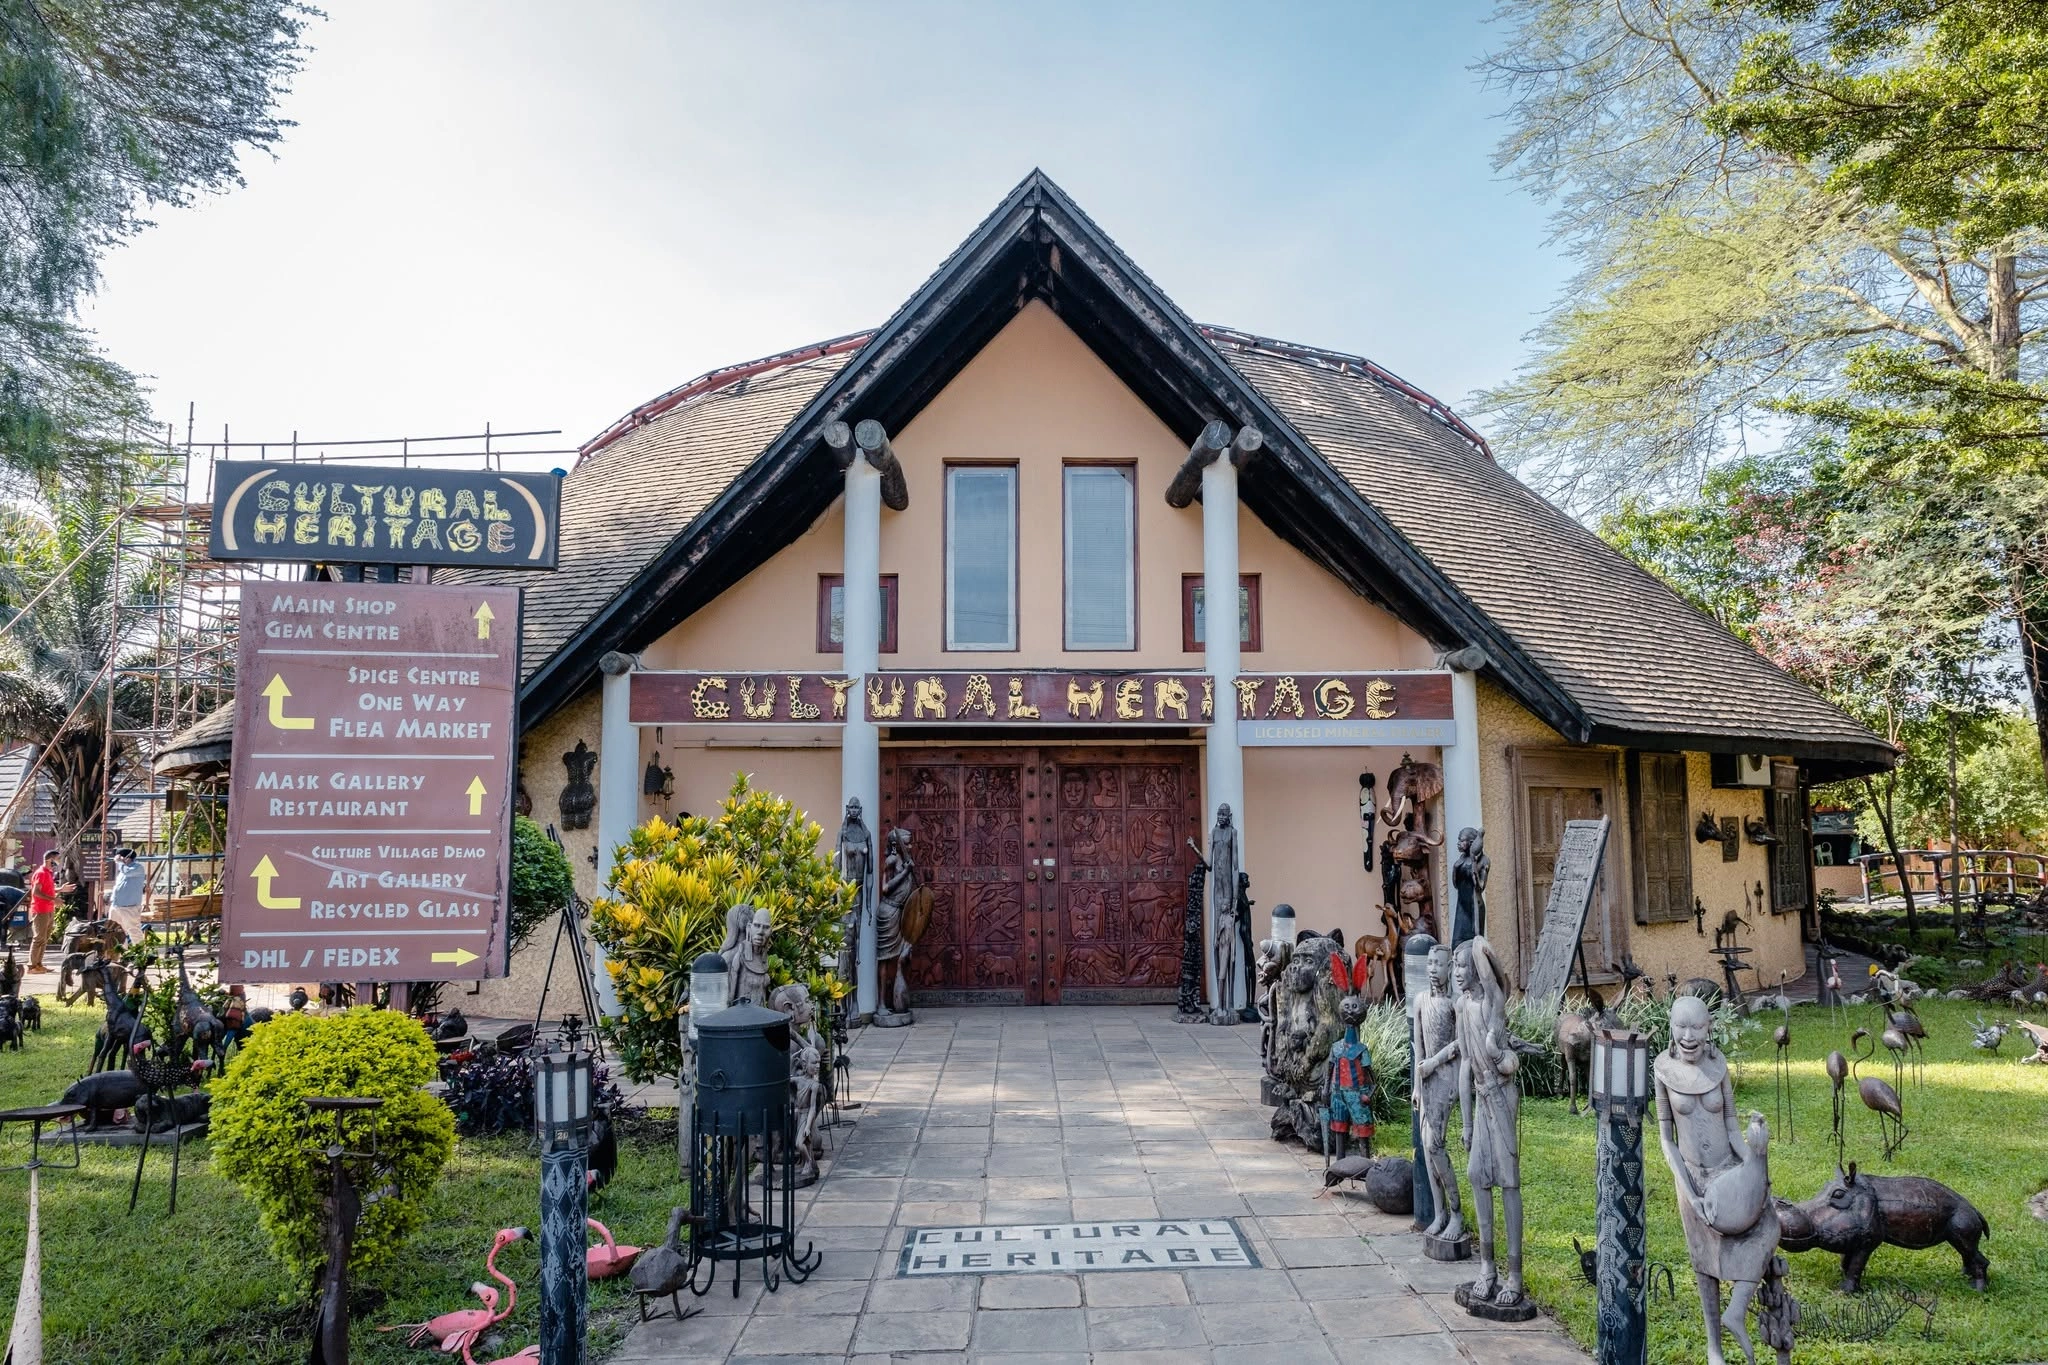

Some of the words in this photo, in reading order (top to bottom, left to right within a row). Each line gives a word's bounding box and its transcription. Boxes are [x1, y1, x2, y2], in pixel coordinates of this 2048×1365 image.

[258, 480, 511, 521] CULTURAL
[254, 510, 516, 553] HERITAGE
[271, 595, 335, 614] MAIN
[345, 597, 397, 615] SHOP
[264, 621, 314, 640] GEM
[322, 622, 399, 641] CENTRE
[347, 666, 398, 684] SPICE
[407, 667, 480, 685] CENTRE
[358, 693, 402, 711] ONE
[412, 694, 466, 712] WAY
[690, 675, 1041, 720] CULTURAL
[1066, 676, 1400, 721] HERITAGE
[329, 718, 385, 738] FLEA
[396, 719, 491, 739] MARKET
[1255, 727, 1321, 739] LICENSED
[255, 771, 320, 790] MASK
[329, 772, 426, 790] GALLERY
[269, 798, 408, 817] RESTAURANT
[311, 846, 371, 859] CULTURE
[378, 845, 439, 859] VILLAGE
[444, 845, 486, 859] DEMO
[327, 871, 370, 889] ART
[378, 871, 467, 889] GALLERY
[310, 900, 410, 919] RECYCLED
[418, 900, 481, 919] GLASS
[244, 949, 290, 969] DHL
[300, 949, 315, 968] /
[323, 948, 400, 967] FEDEX
[918, 1222, 1232, 1245] CULTURAL
[912, 1247, 1246, 1270] HERITAGE
